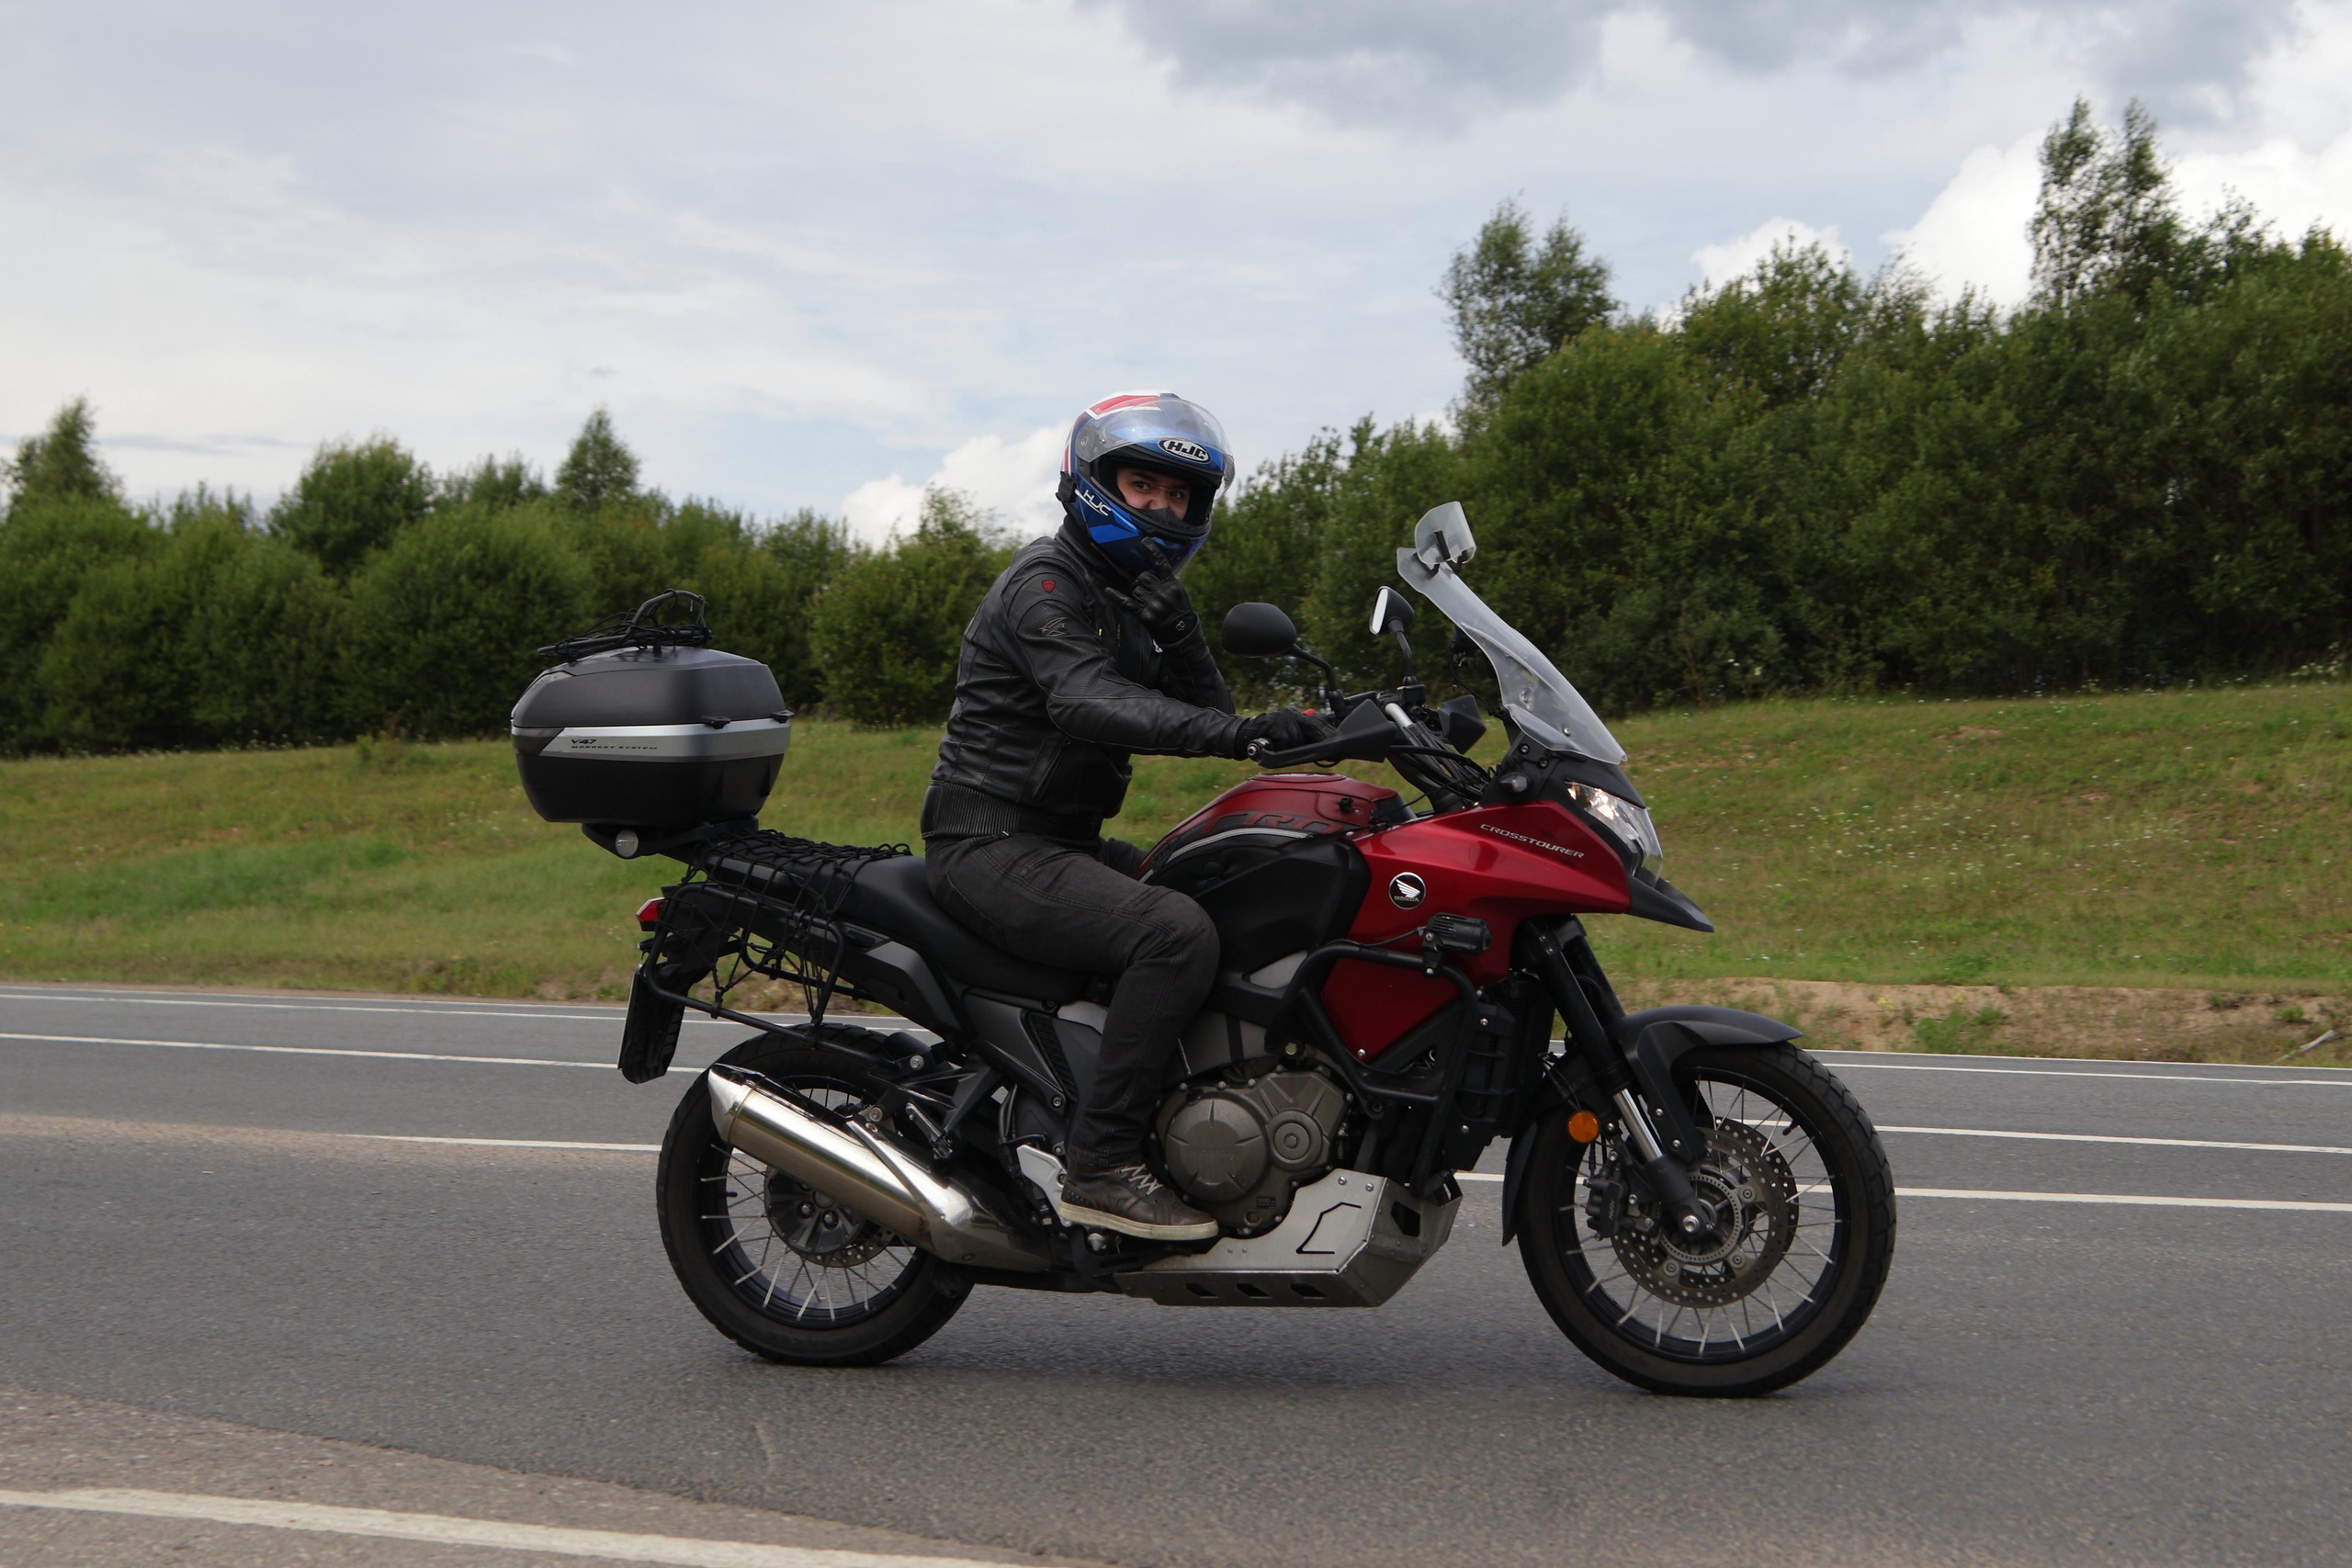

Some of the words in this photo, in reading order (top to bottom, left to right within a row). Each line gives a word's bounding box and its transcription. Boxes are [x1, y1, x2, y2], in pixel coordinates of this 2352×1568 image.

[1167, 441, 1205, 459] HJC
[1084, 490, 1112, 516] HJC
[1479, 823, 1585, 859] CROSSTOURER
